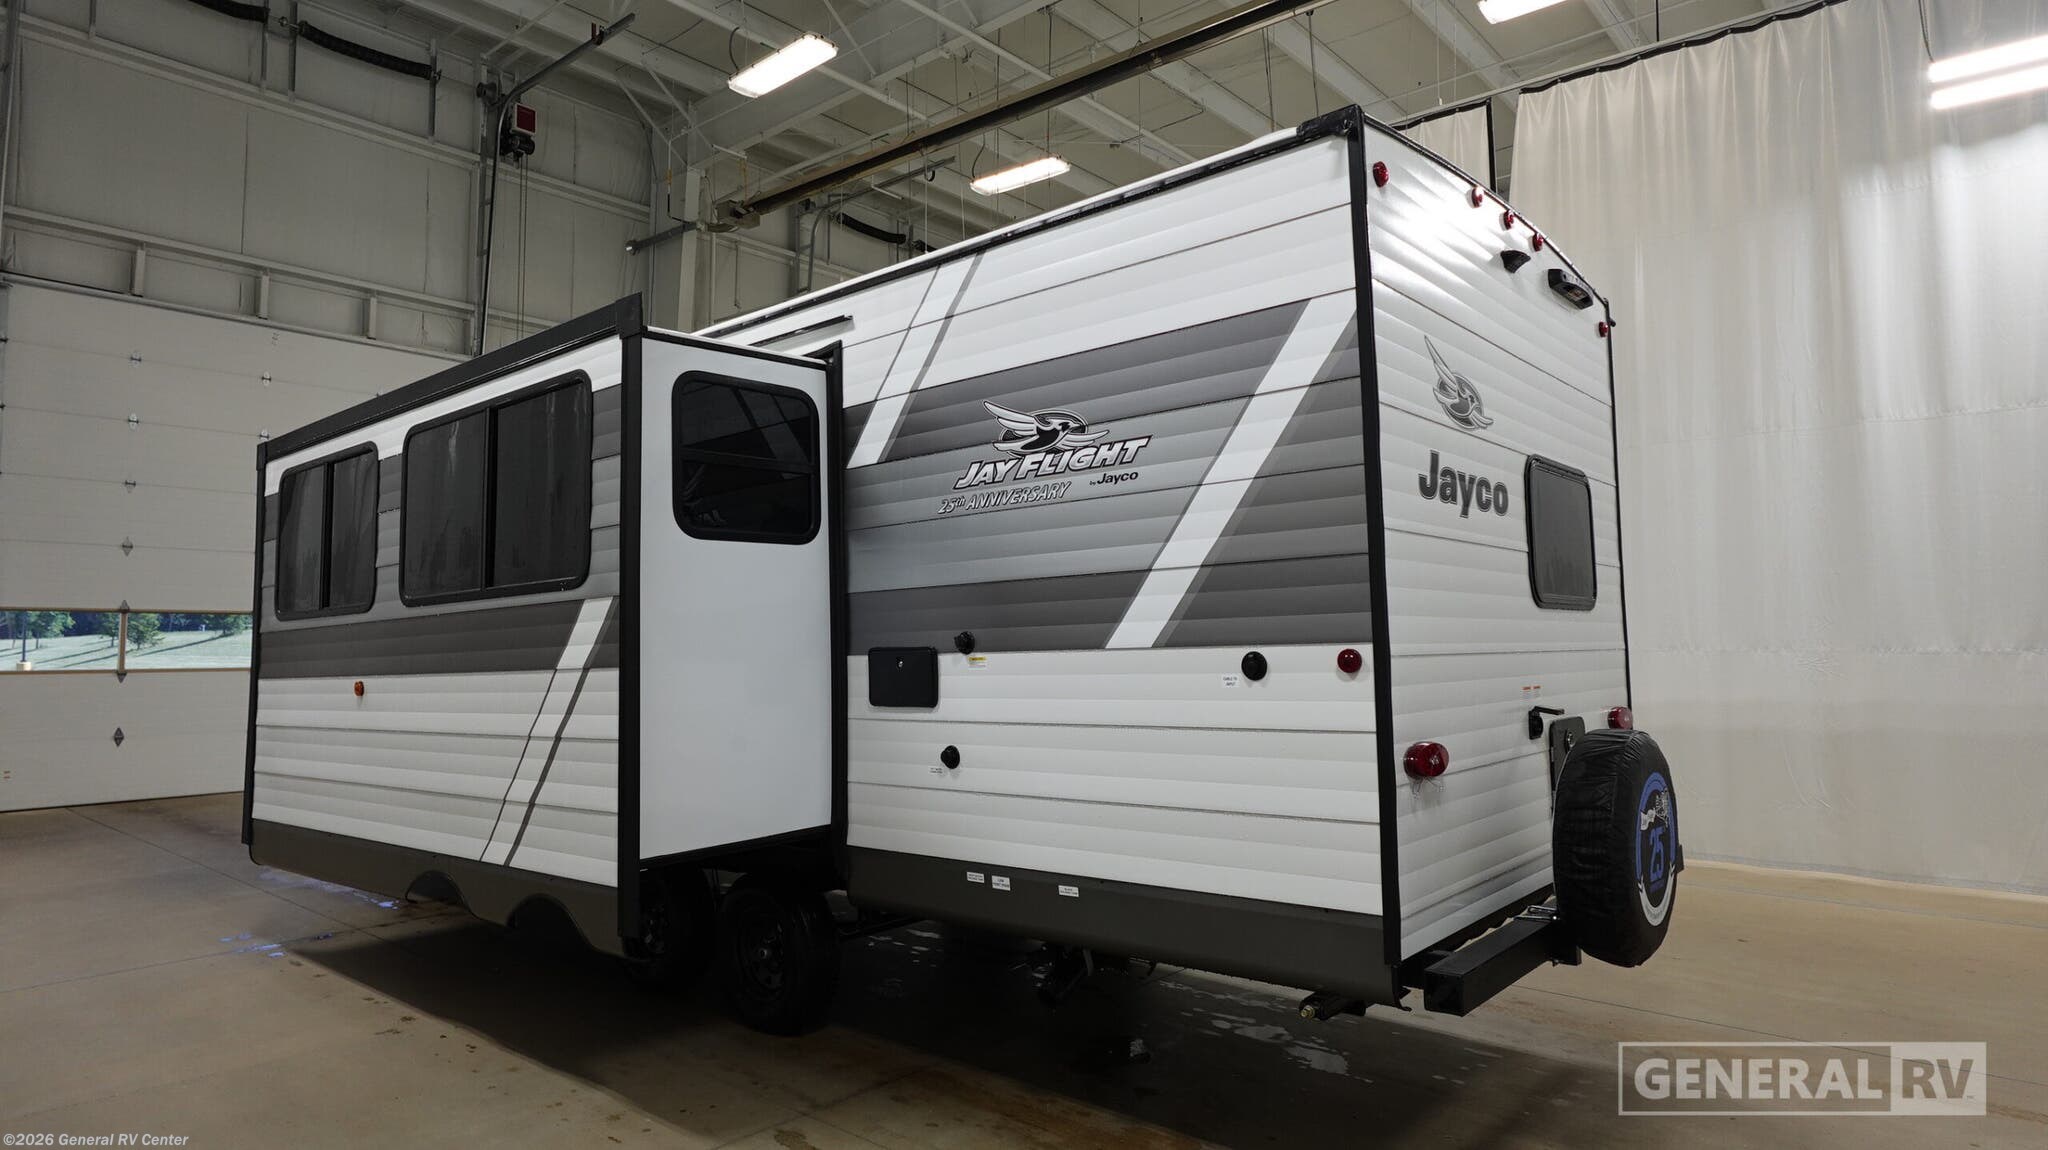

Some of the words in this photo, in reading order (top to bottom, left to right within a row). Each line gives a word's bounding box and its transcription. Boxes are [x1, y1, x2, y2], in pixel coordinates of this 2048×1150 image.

[953, 457, 1023, 490] JAY
[1012, 435, 1153, 481] FLIGHT
[1097, 472, 1139, 485] Jayco
[1418, 449, 1509, 518] Jayco
[938, 496, 966, 514] 25th
[966, 481, 1072, 510] ANNIVERSARY
